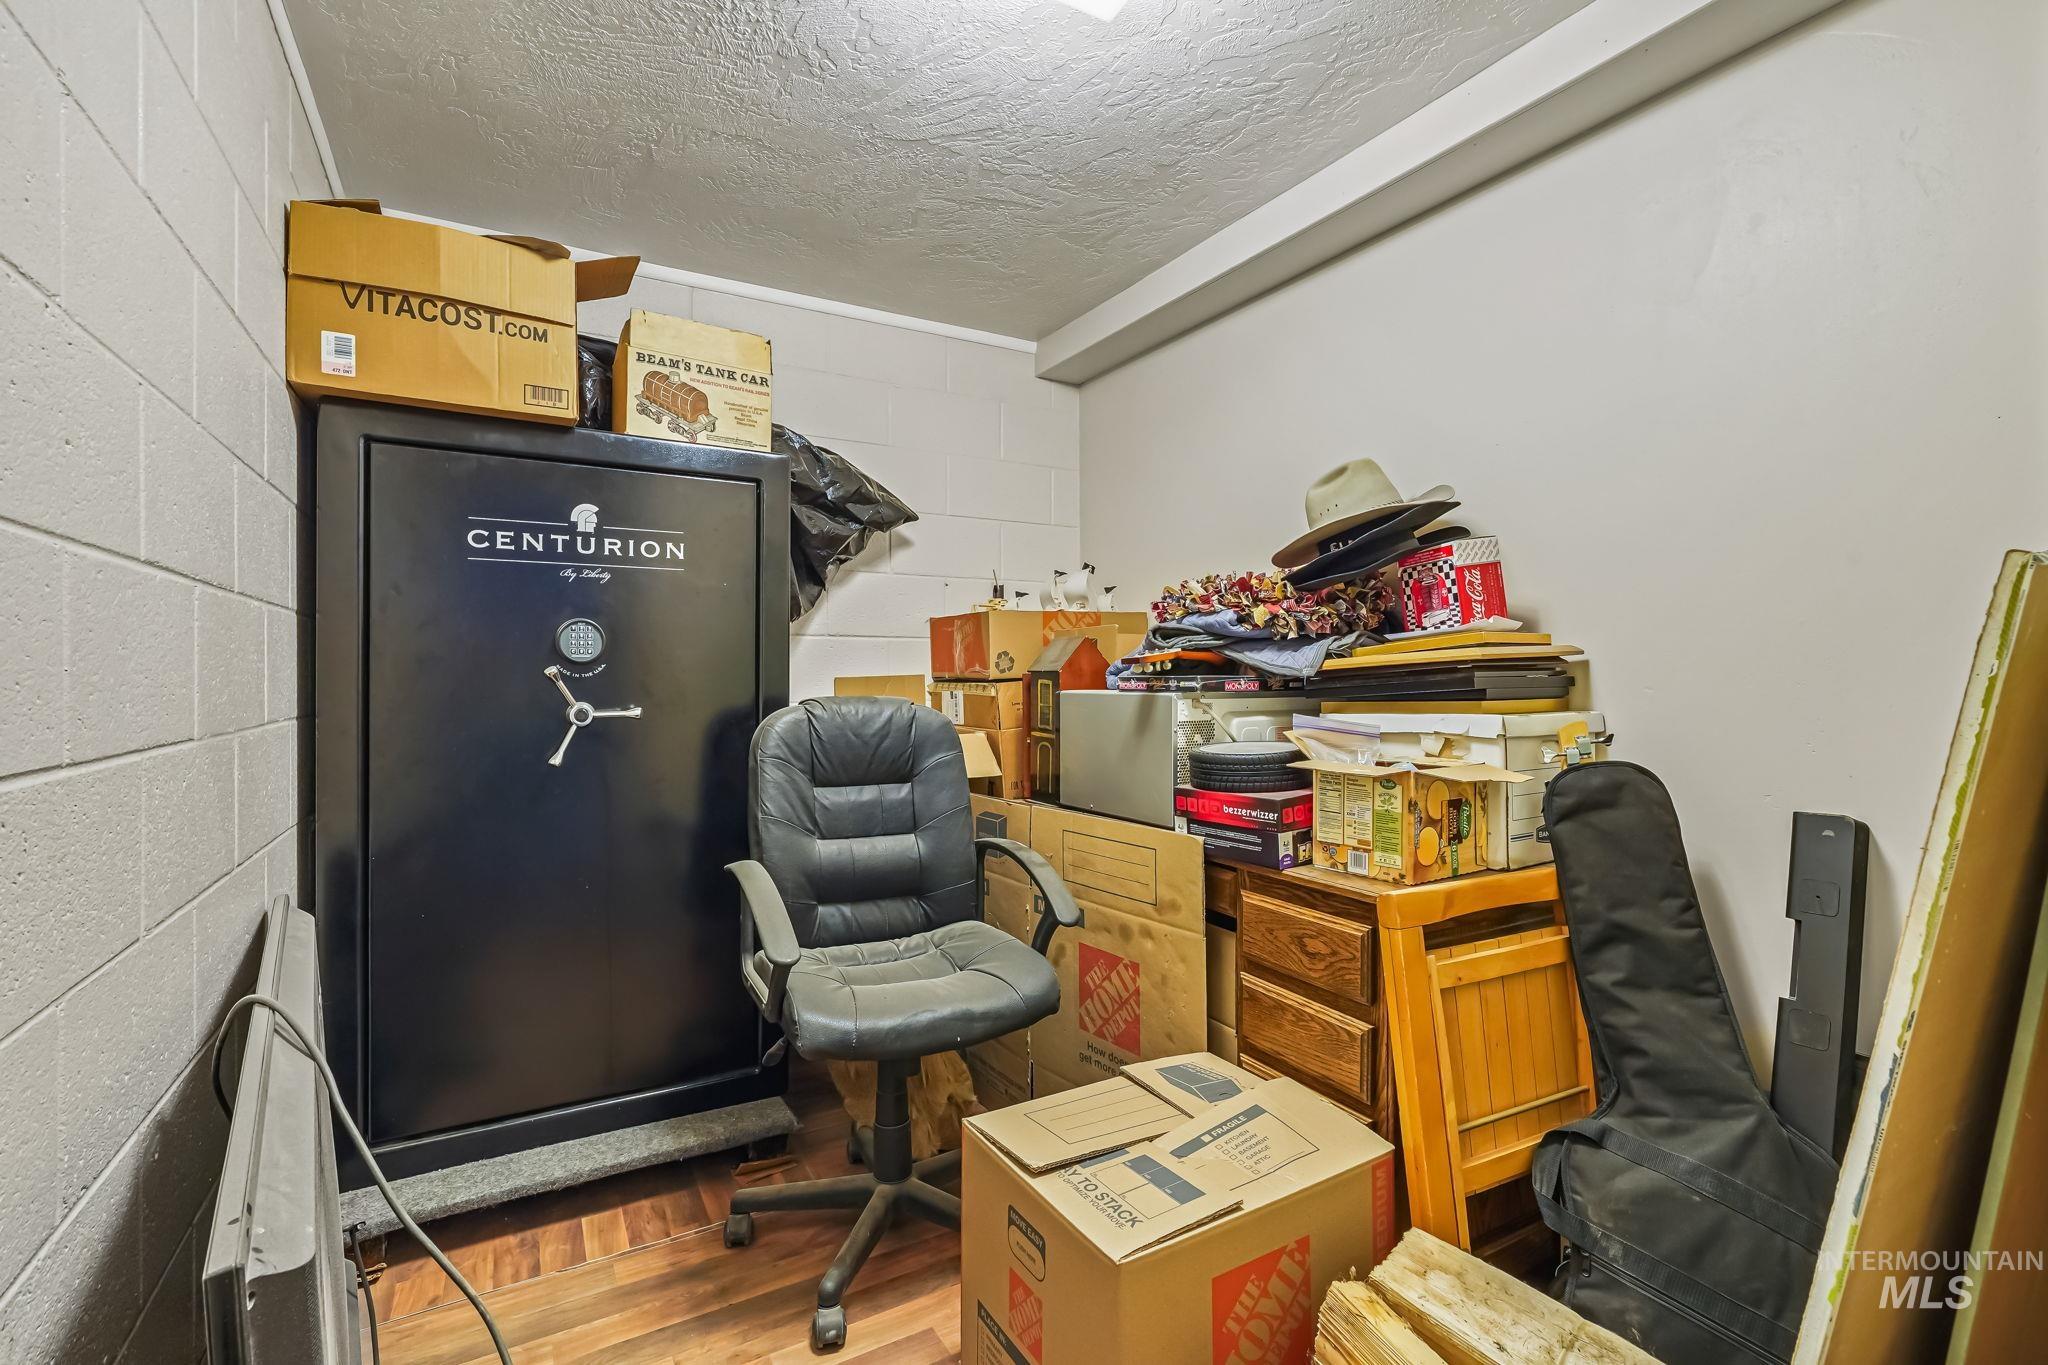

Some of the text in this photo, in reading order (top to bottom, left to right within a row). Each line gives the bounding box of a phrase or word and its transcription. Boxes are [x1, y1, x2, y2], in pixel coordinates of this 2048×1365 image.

[338, 281, 548, 343] VITACOST.COM
[635, 351, 770, 388] BEAM'S TANK CAR
[467, 529, 685, 560] CENTURION
[559, 567, 612, 584] By Liberty
[1223, 804, 1279, 821] bezzerwizzer
[1085, 959, 1109, 991] THE
[1079, 957, 1140, 1034] HOME
[1102, 995, 1140, 1042] DEPOT
[1079, 1051, 1117, 1077] get more
[1087, 1040, 1107, 1058] How
[1210, 1115, 1248, 1137] FRAGILE
[1223, 1128, 1250, 1146] KITCHEN
[1230, 1133, 1258, 1151] LAUNDRY
[1238, 1135, 1270, 1156] BASEMENT
[1245, 1144, 1271, 1160] GARAGE
[1253, 1154, 1271, 1166] ATTIC
[1063, 1176, 1091, 1200] OPTIMIZE
[1088, 1198, 1108, 1216] YOUR
[1077, 1176, 1099, 1192] TO
[1095, 1192, 1144, 1228] STACK
[1376, 1168, 1388, 1247] EDIUM
[1222, 1271, 1264, 1337] THE
[1224, 1238, 1311, 1365] OME
